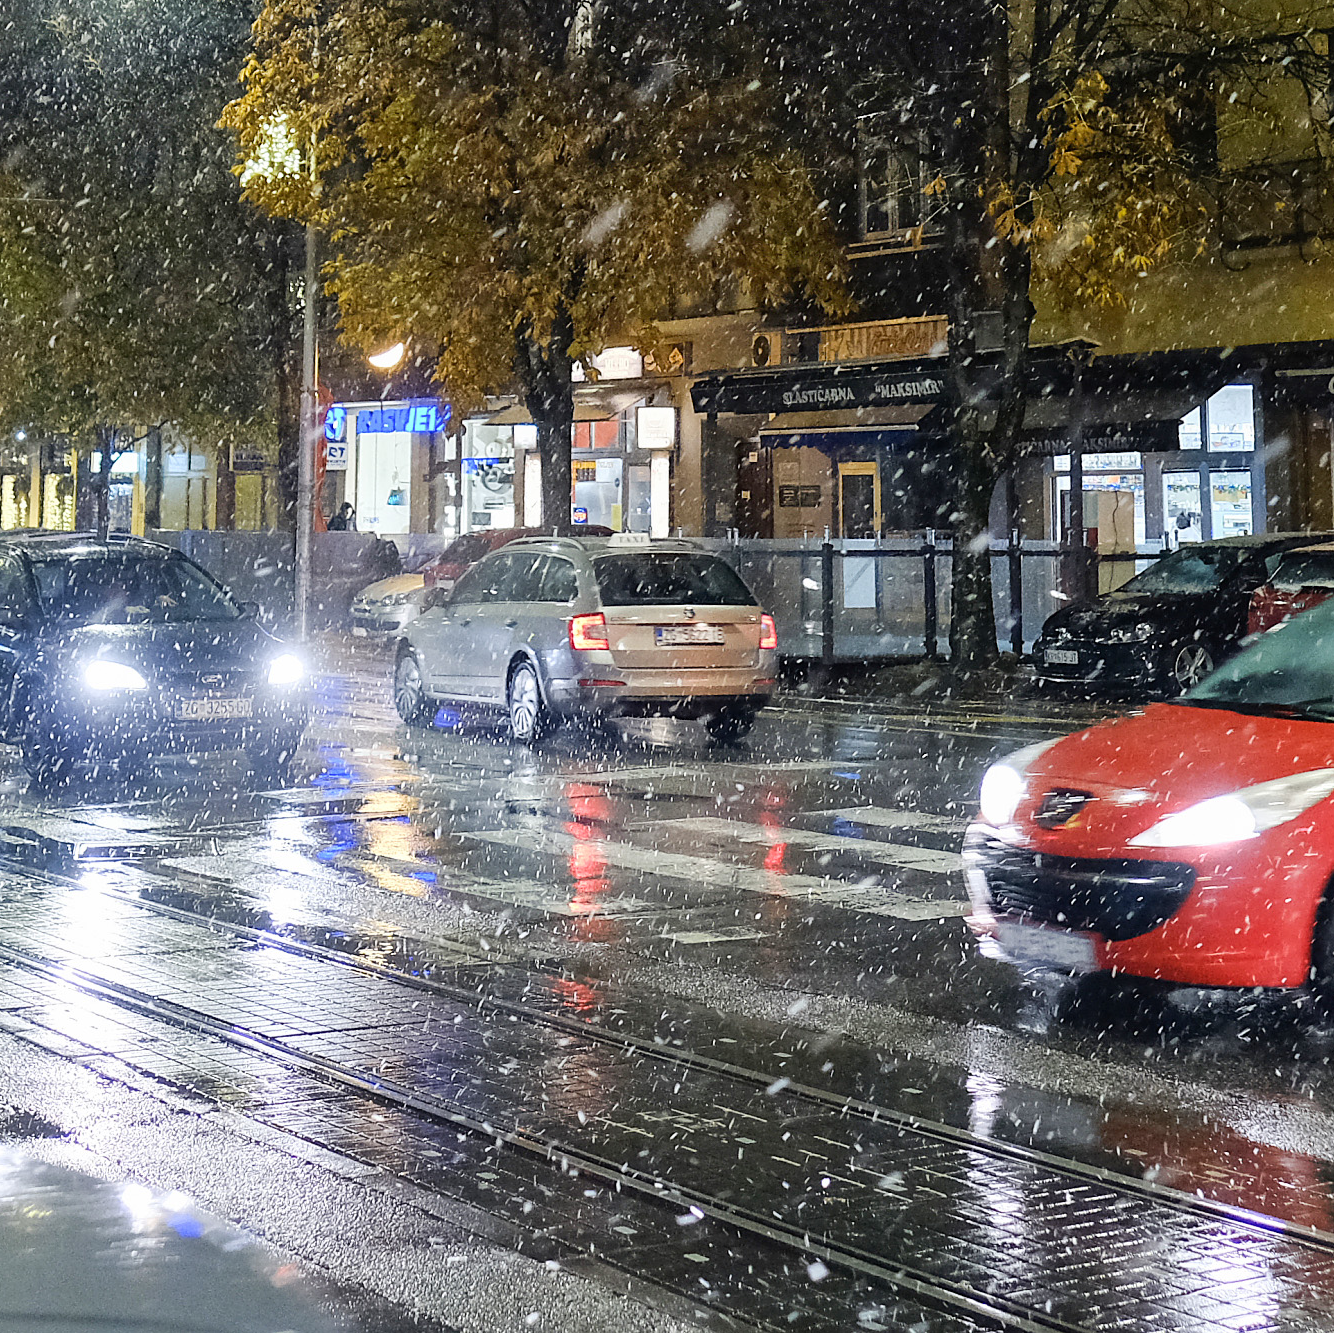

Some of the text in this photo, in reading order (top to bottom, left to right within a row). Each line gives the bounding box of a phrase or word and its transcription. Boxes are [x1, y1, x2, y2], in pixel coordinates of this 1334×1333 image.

[782, 385, 856, 405] SLASTIČARNA
[328, 446, 346, 458] RT
[619, 536, 644, 544] TAXI
[185, 702, 198, 715] ZG
